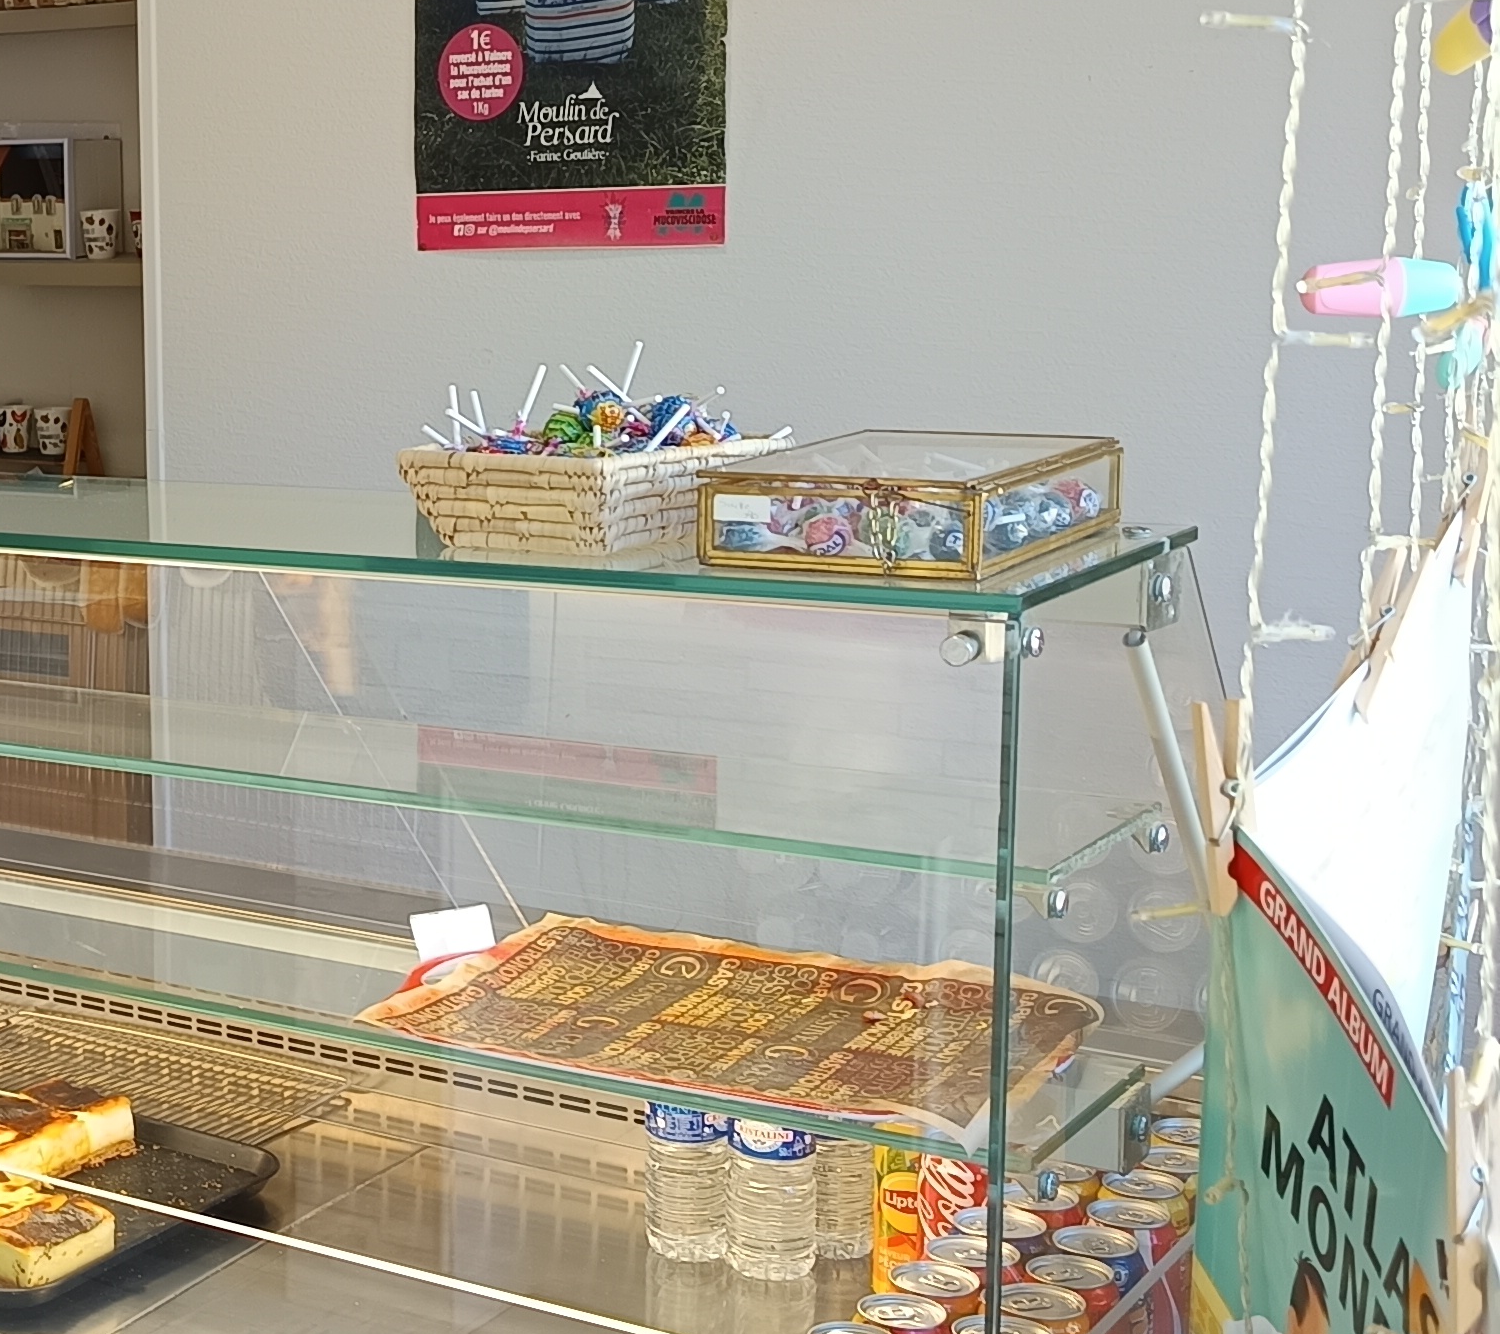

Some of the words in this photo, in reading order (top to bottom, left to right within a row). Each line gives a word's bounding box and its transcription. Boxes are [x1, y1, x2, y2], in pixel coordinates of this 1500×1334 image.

[470, 29, 492, 50] 1€
[471, 89, 480, 99] de
[517, 94, 586, 124] Moulin
[589, 99, 609, 121] de
[524, 112, 620, 147] Persard
[1259, 881, 1326, 985] GRAND
[1328, 985, 1389, 1095] ALBUM
[885, 1190, 919, 1209] Lipt
